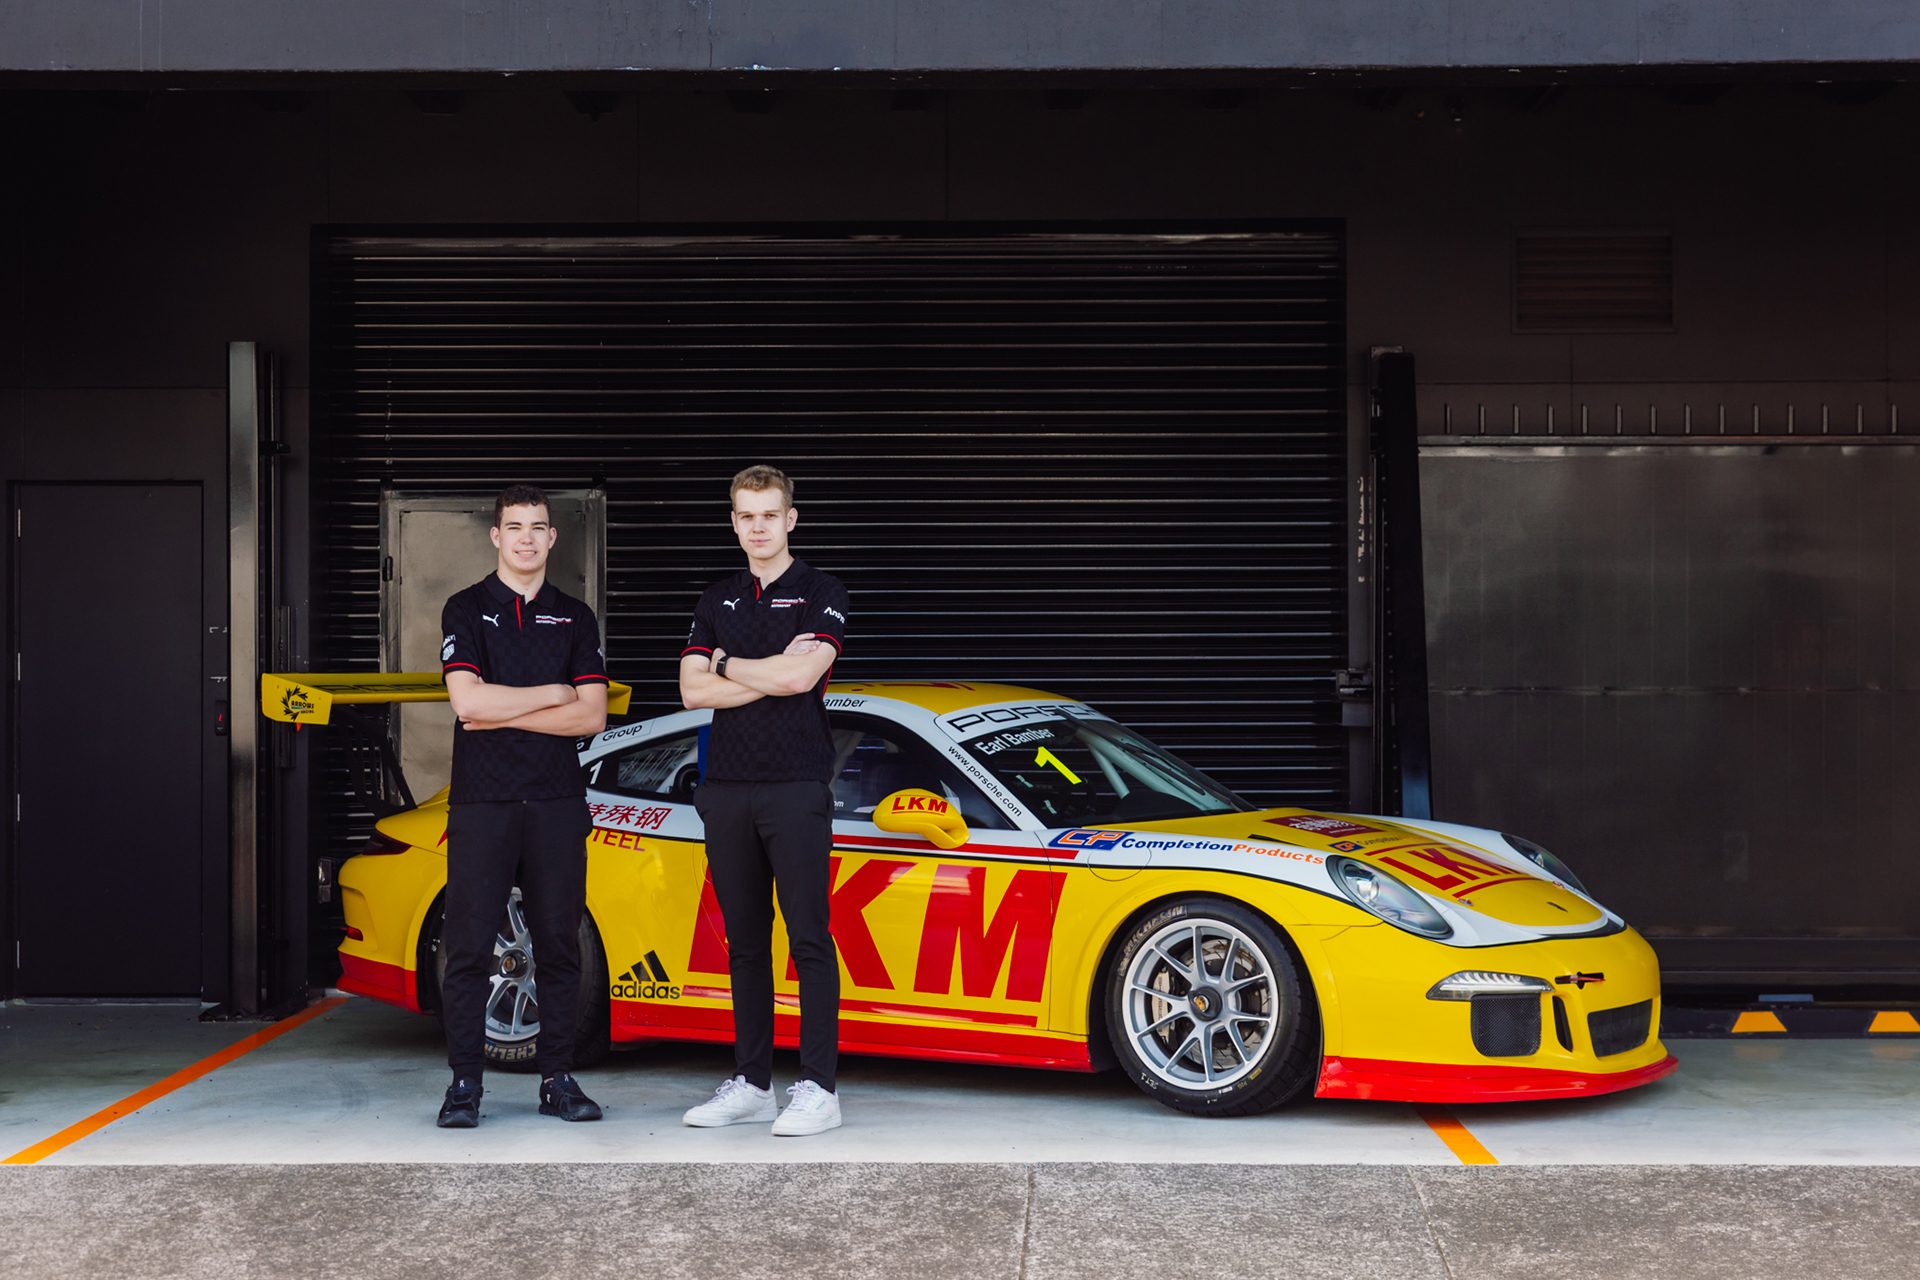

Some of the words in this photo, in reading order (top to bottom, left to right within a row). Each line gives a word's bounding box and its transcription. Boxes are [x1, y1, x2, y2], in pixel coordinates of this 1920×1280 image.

[823, 698, 868, 708] amber
[602, 724, 643, 742] Group
[975, 736, 1008, 756] Earl
[1004, 727, 1055, 747] Bamber
[1034, 746, 1083, 785] 1
[948, 746, 1022, 818] www.porsche.com
[892, 797, 948, 814] LKM
[592, 825, 646, 852] TEEL
[611, 981, 681, 999] adidas
